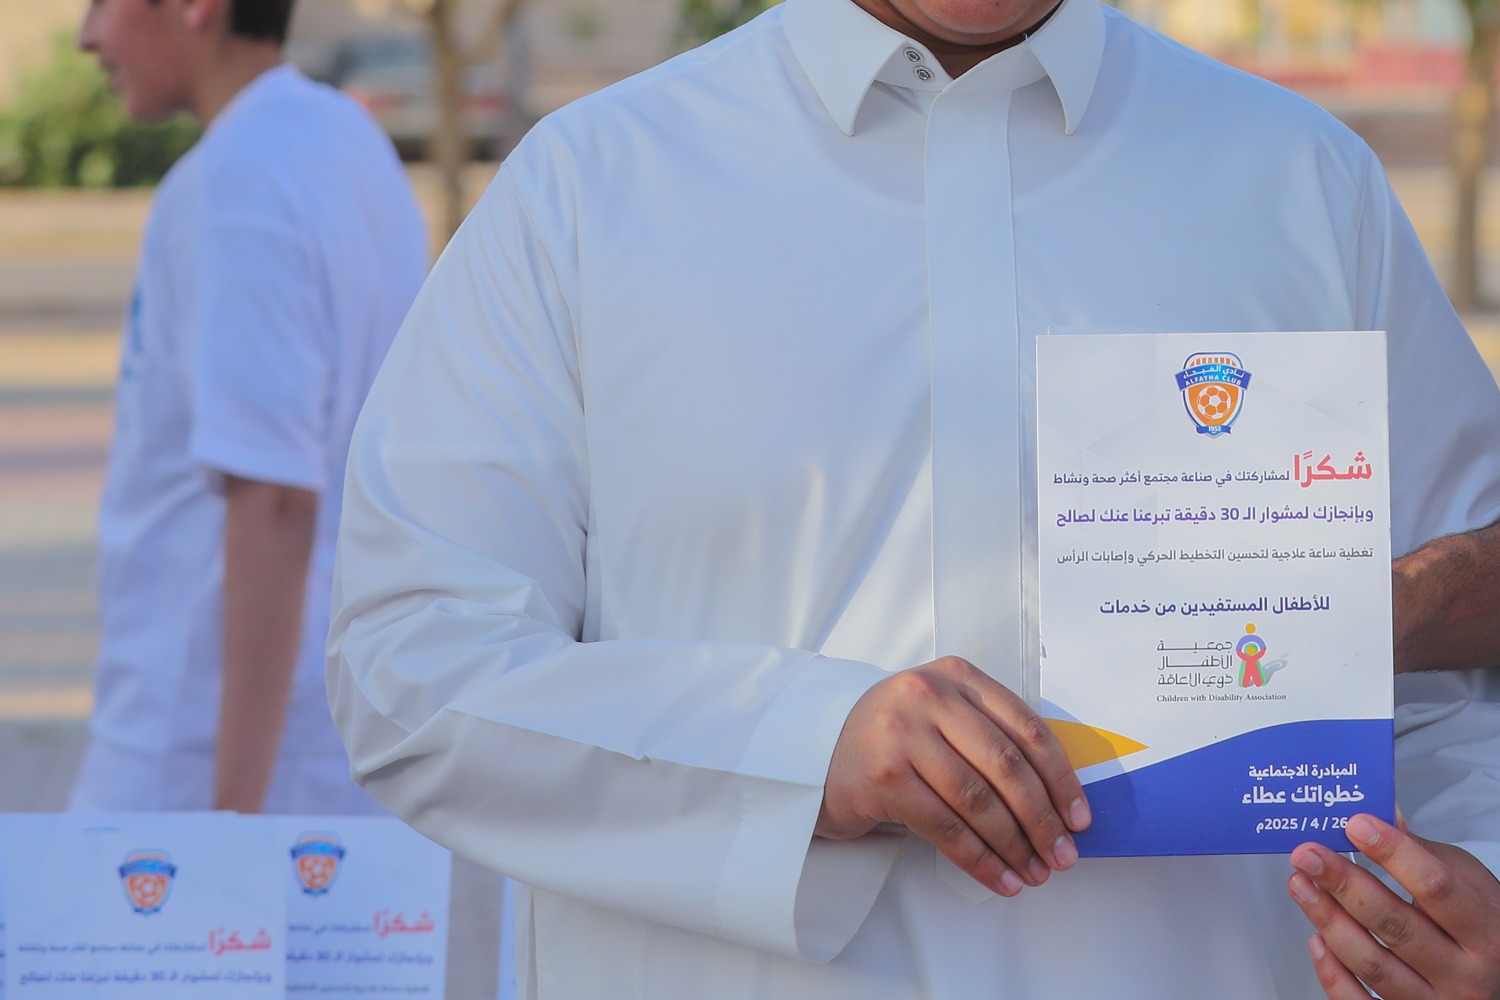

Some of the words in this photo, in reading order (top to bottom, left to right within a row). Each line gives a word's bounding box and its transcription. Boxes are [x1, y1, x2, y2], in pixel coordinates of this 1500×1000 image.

[1185, 374, 1220, 386] ALFAYHA
[1222, 375, 1242, 386] CLUB
[1180, 471, 1213, 482] صناعة
[1234, 469, 1290, 484] لمشاركتك
[1292, 449, 1373, 489] شكرًا
[1053, 472, 1090, 487] ونشاط
[1091, 473, 1117, 484] صحة
[1118, 469, 1141, 486] أكثر
[1143, 472, 1179, 486] مجتمع
[1215, 470, 1232, 488] في
[1056, 508, 1096, 528] لصالح
[1099, 508, 1129, 522] عنك
[1133, 508, 1172, 526] تبرعنا
[1174, 505, 1216, 525] دقيقة
[1220, 507, 1240, 521] 30
[1258, 504, 1309, 524] لمشوار
[1312, 505, 1374, 524] وبإنجازك
[1056, 548, 1089, 565] الرأس
[1091, 550, 1135, 565] وإصابات
[1136, 549, 1176, 567] الحركي
[1179, 548, 1225, 563] التخطيط
[1227, 548, 1269, 563] لتحسين
[1271, 547, 1306, 562] علاجية
[1308, 547, 1337, 558] ساعة
[1338, 546, 1374, 561] تغطية
[1099, 599, 1151, 614] خدمات
[1154, 602, 1177, 616] من
[1180, 596, 1268, 617] المستفيدين
[1272, 594, 1330, 615] للأطفال
[1156, 694, 1189, 702] Children
[1190, 694, 1207, 702] with
[1208, 694, 1244, 703] Disability
[1245, 693, 1287, 701] Association
[1248, 763, 1309, 781] الاجتماعية
[1311, 763, 1357, 780] المبادرة
[1241, 785, 1287, 804] عطاء
[1290, 784, 1365, 808] خطواتك
[1310, 817, 1320, 830] 4
